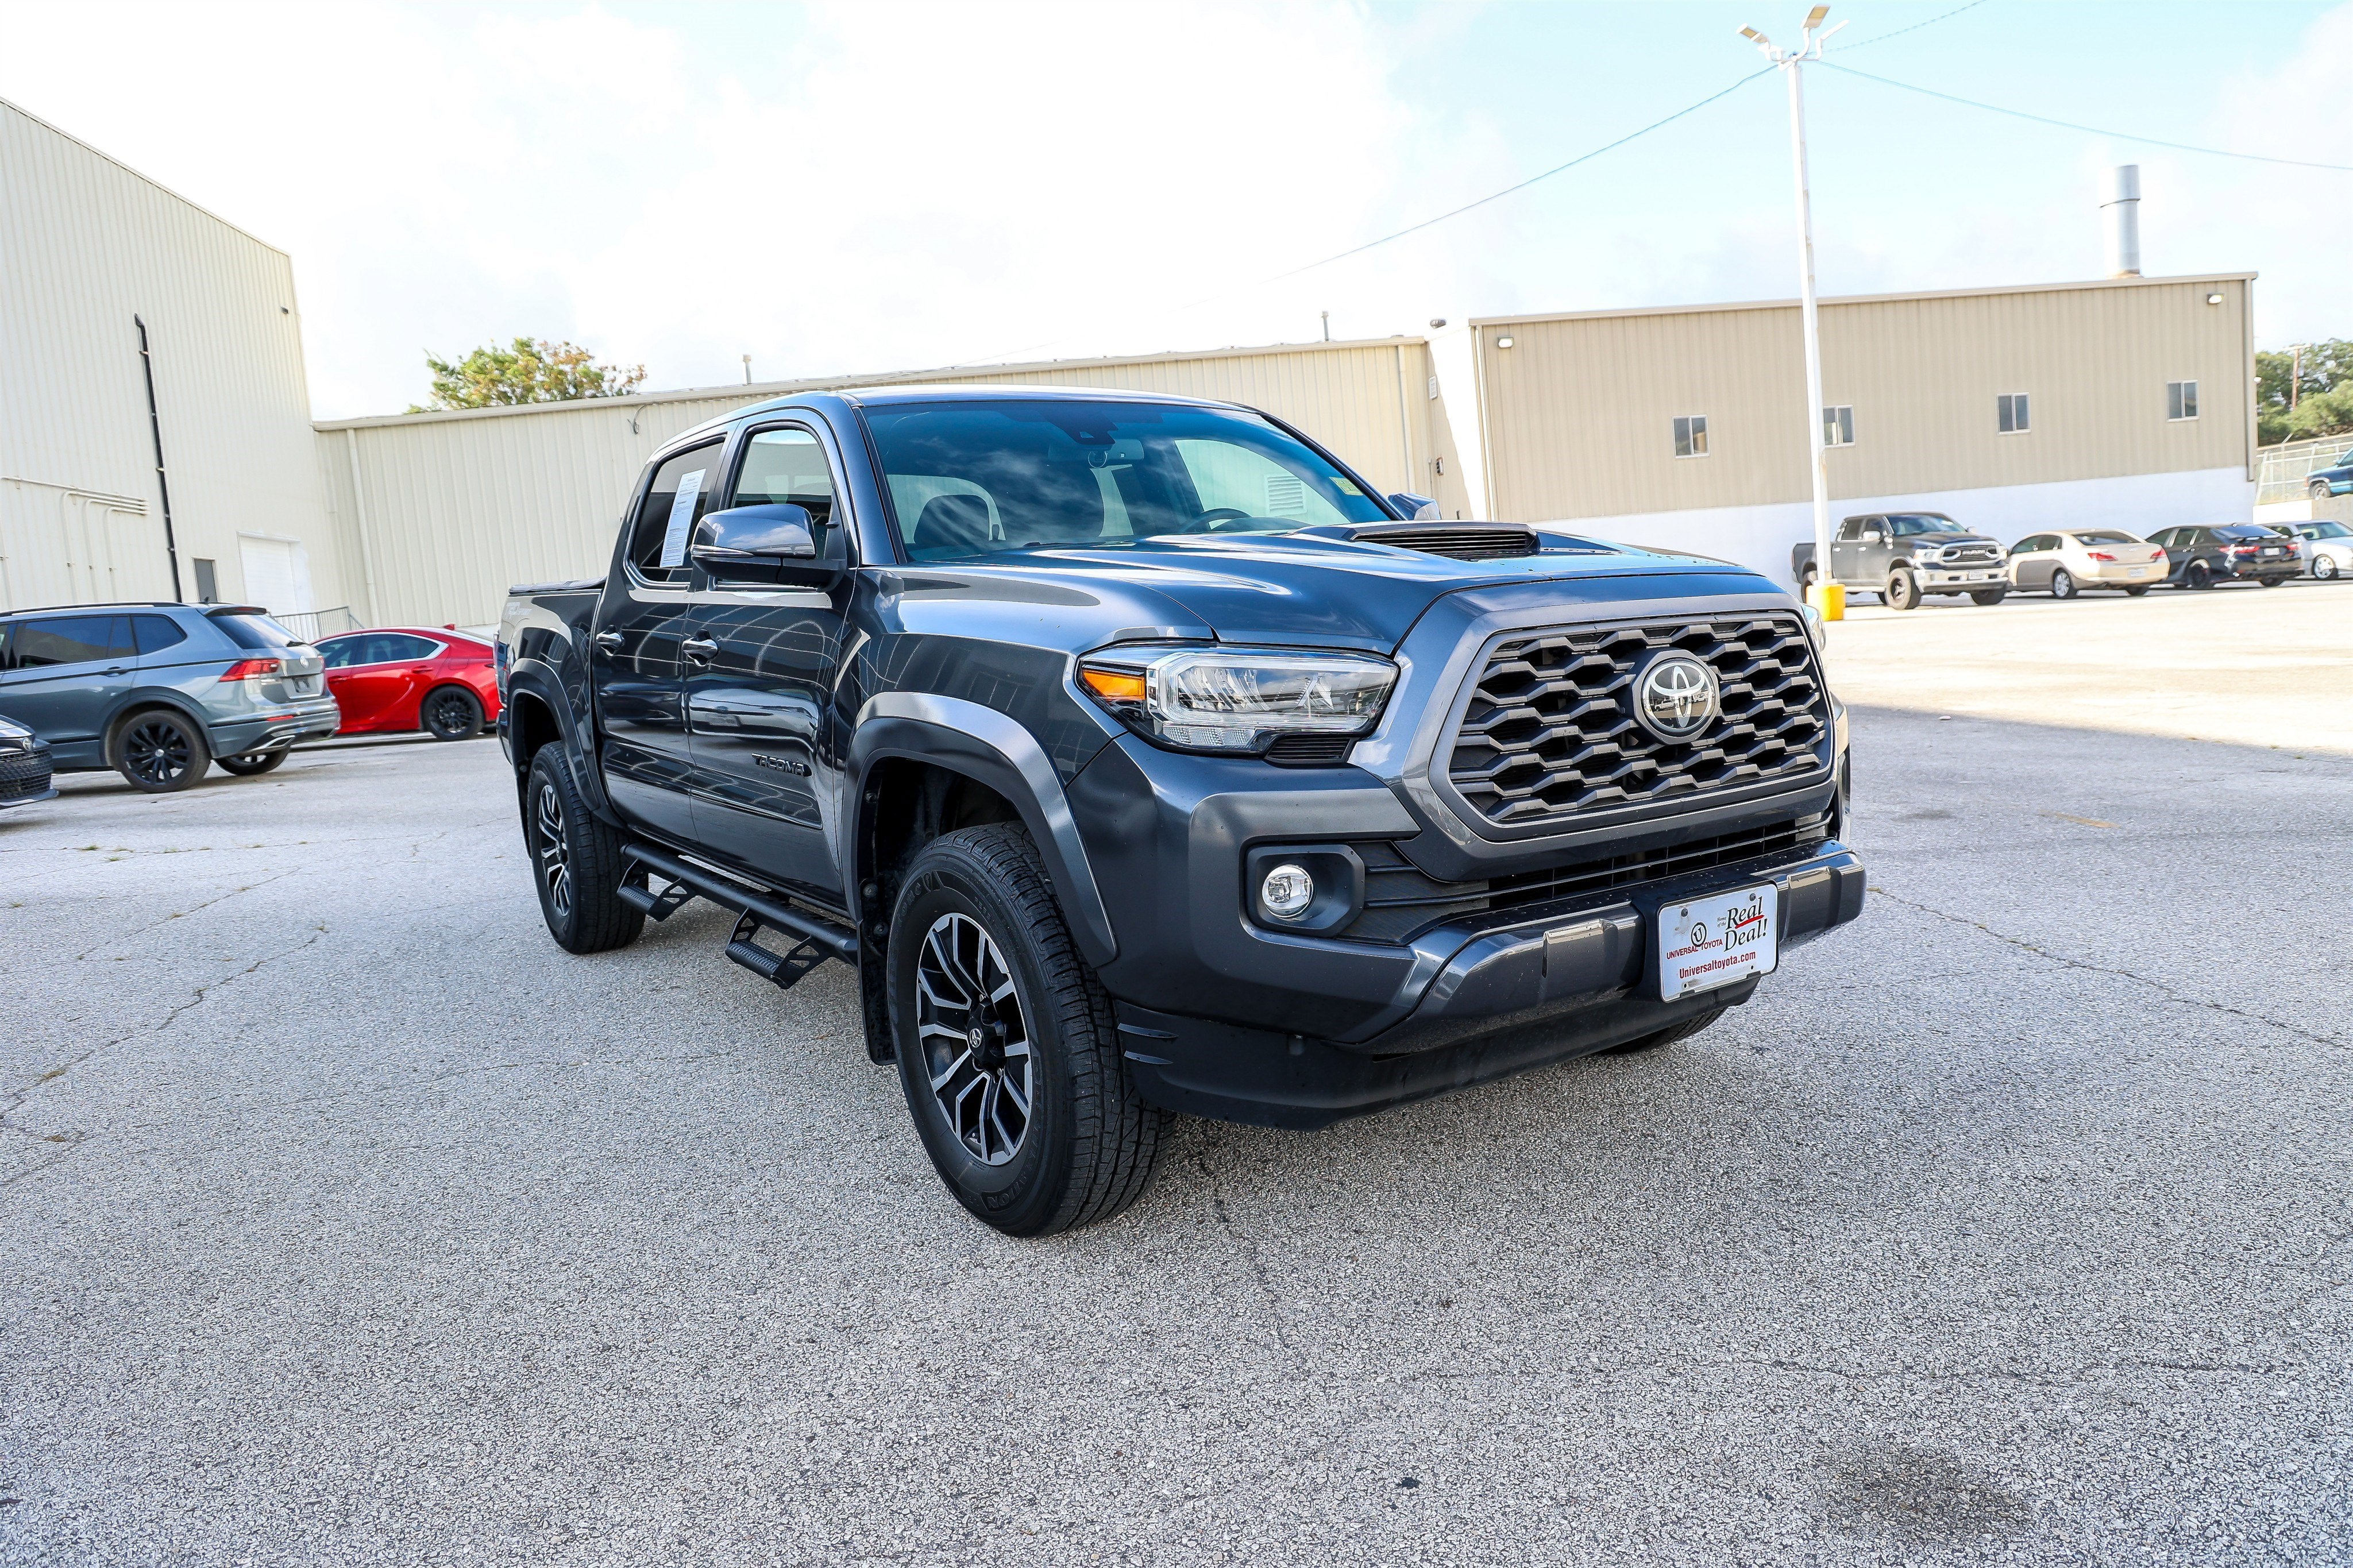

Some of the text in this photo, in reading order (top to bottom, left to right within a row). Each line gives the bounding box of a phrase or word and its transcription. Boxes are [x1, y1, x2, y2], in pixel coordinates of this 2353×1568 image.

[751, 752, 807, 776] TACOMA
[1726, 896, 1763, 930] Real
[1723, 918, 1768, 952] Deal!
[1667, 939, 1723, 960] UNIVERSAL TOYOTA
[1679, 951, 1756, 979] Universaltoyota.com
